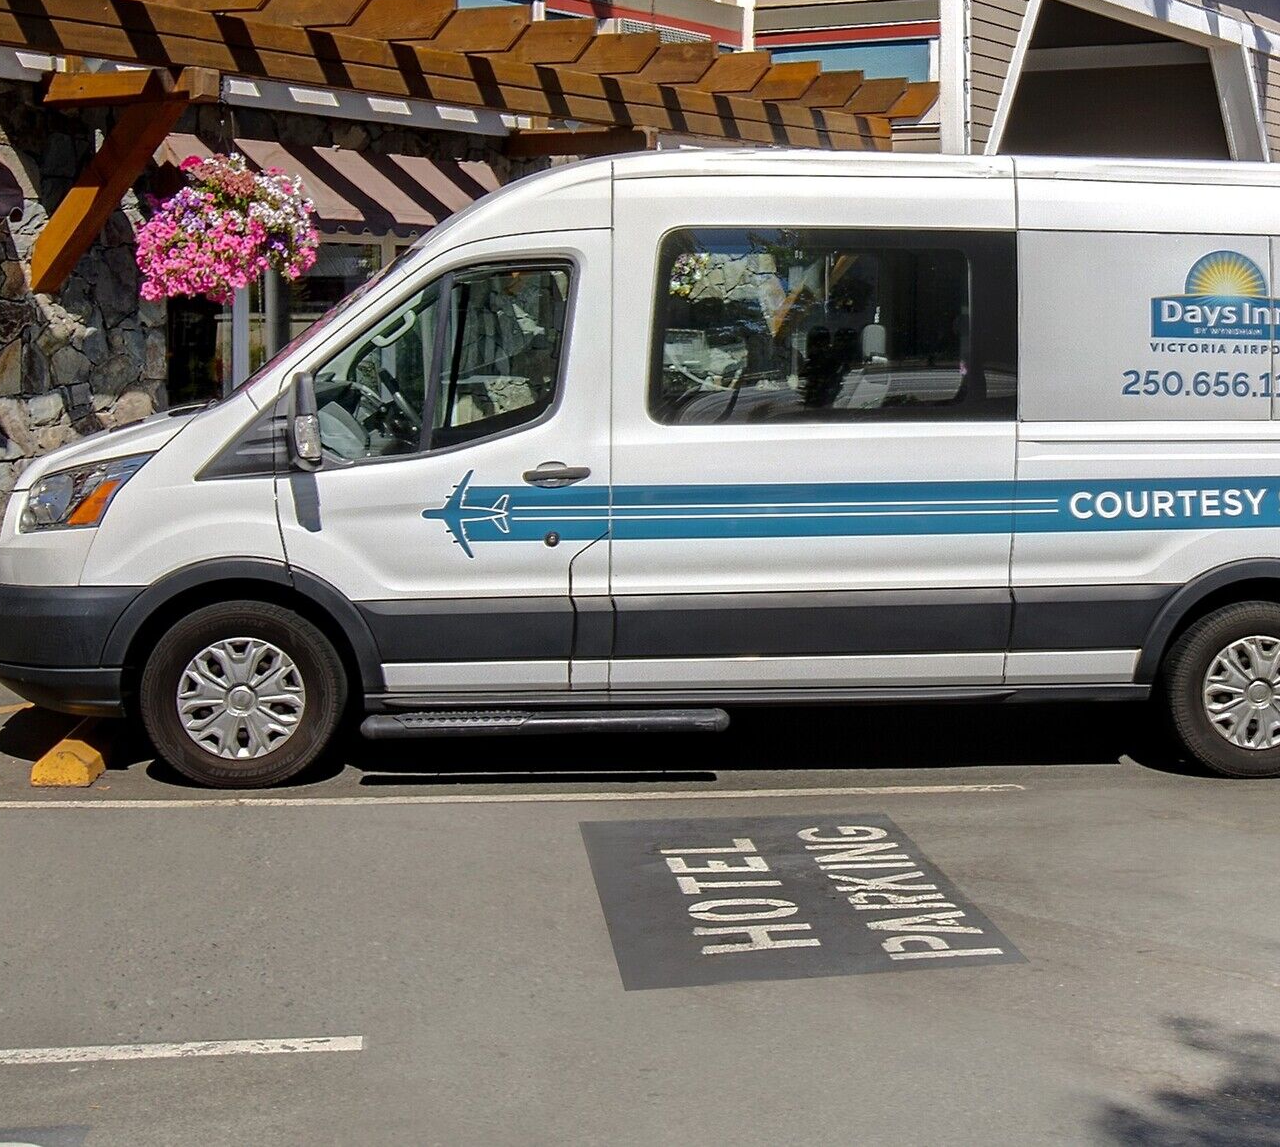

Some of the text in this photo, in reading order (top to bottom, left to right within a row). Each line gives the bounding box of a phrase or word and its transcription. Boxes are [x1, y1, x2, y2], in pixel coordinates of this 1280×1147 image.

[1161, 300, 1237, 326] Days
[1149, 342, 1227, 353] VICTORIA
[1069, 487, 1268, 520] COURTESY
[660, 837, 821, 955] HOTEL
[796, 824, 1005, 961] PARKING
